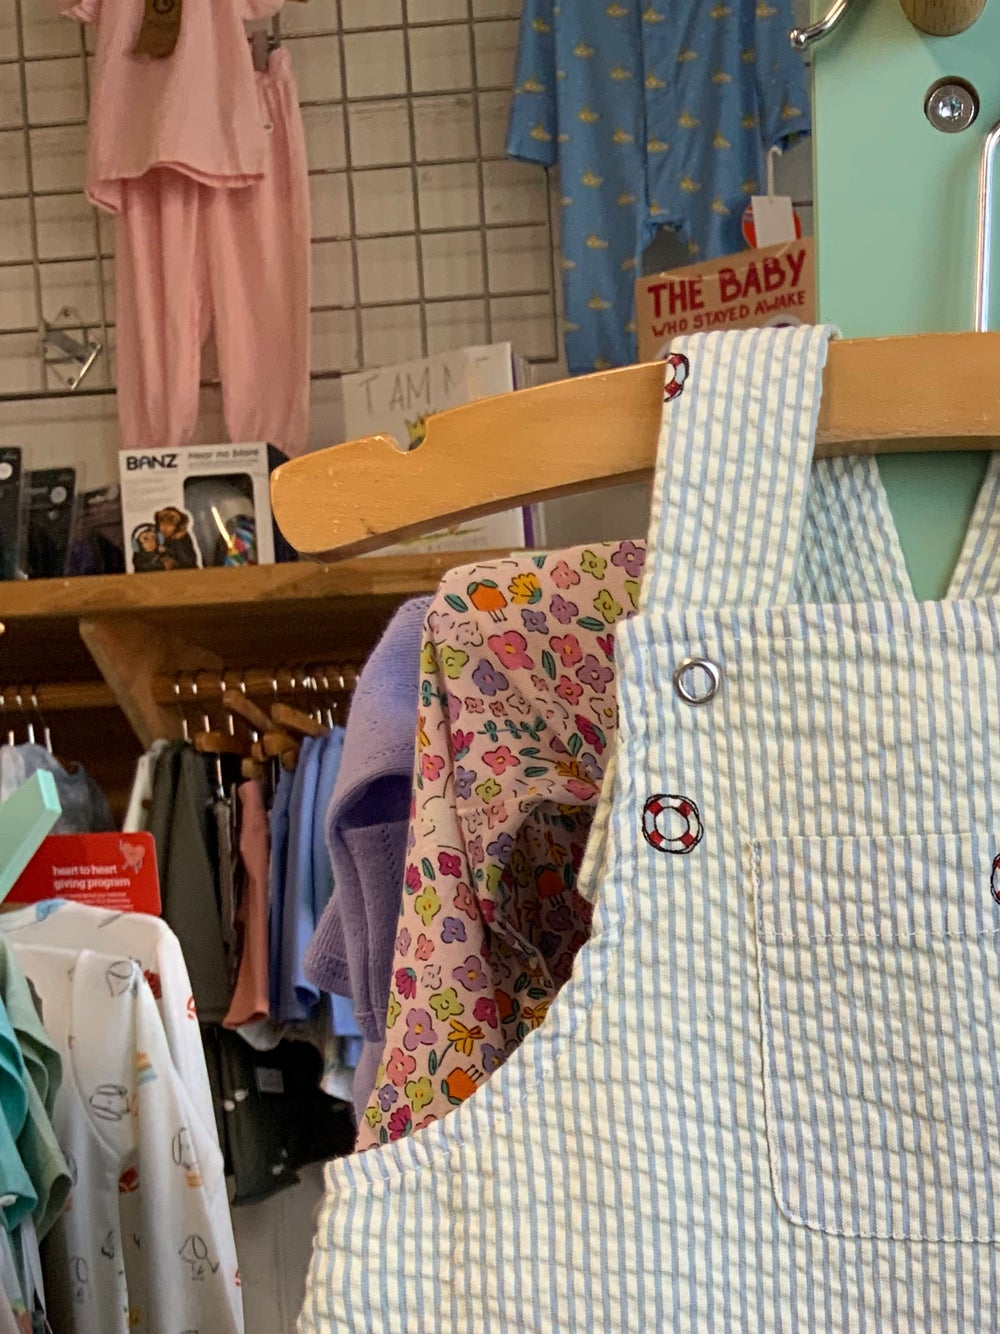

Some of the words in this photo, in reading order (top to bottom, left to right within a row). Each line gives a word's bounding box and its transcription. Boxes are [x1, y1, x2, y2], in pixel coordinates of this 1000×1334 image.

[647, 275, 704, 319] THE
[718, 250, 806, 303] BABY
[652, 319, 688, 338] WHO
[693, 305, 750, 328] STAYED
[754, 290, 806, 316] AWAKE
[388, 366, 431, 412] AM
[126, 453, 178, 471] BANZ
[53, 866, 78, 876] heart
[80, 866, 91, 876] to
[92, 864, 117, 875] heart
[54, 879, 86, 890] giving
[88, 878, 131, 890] program
